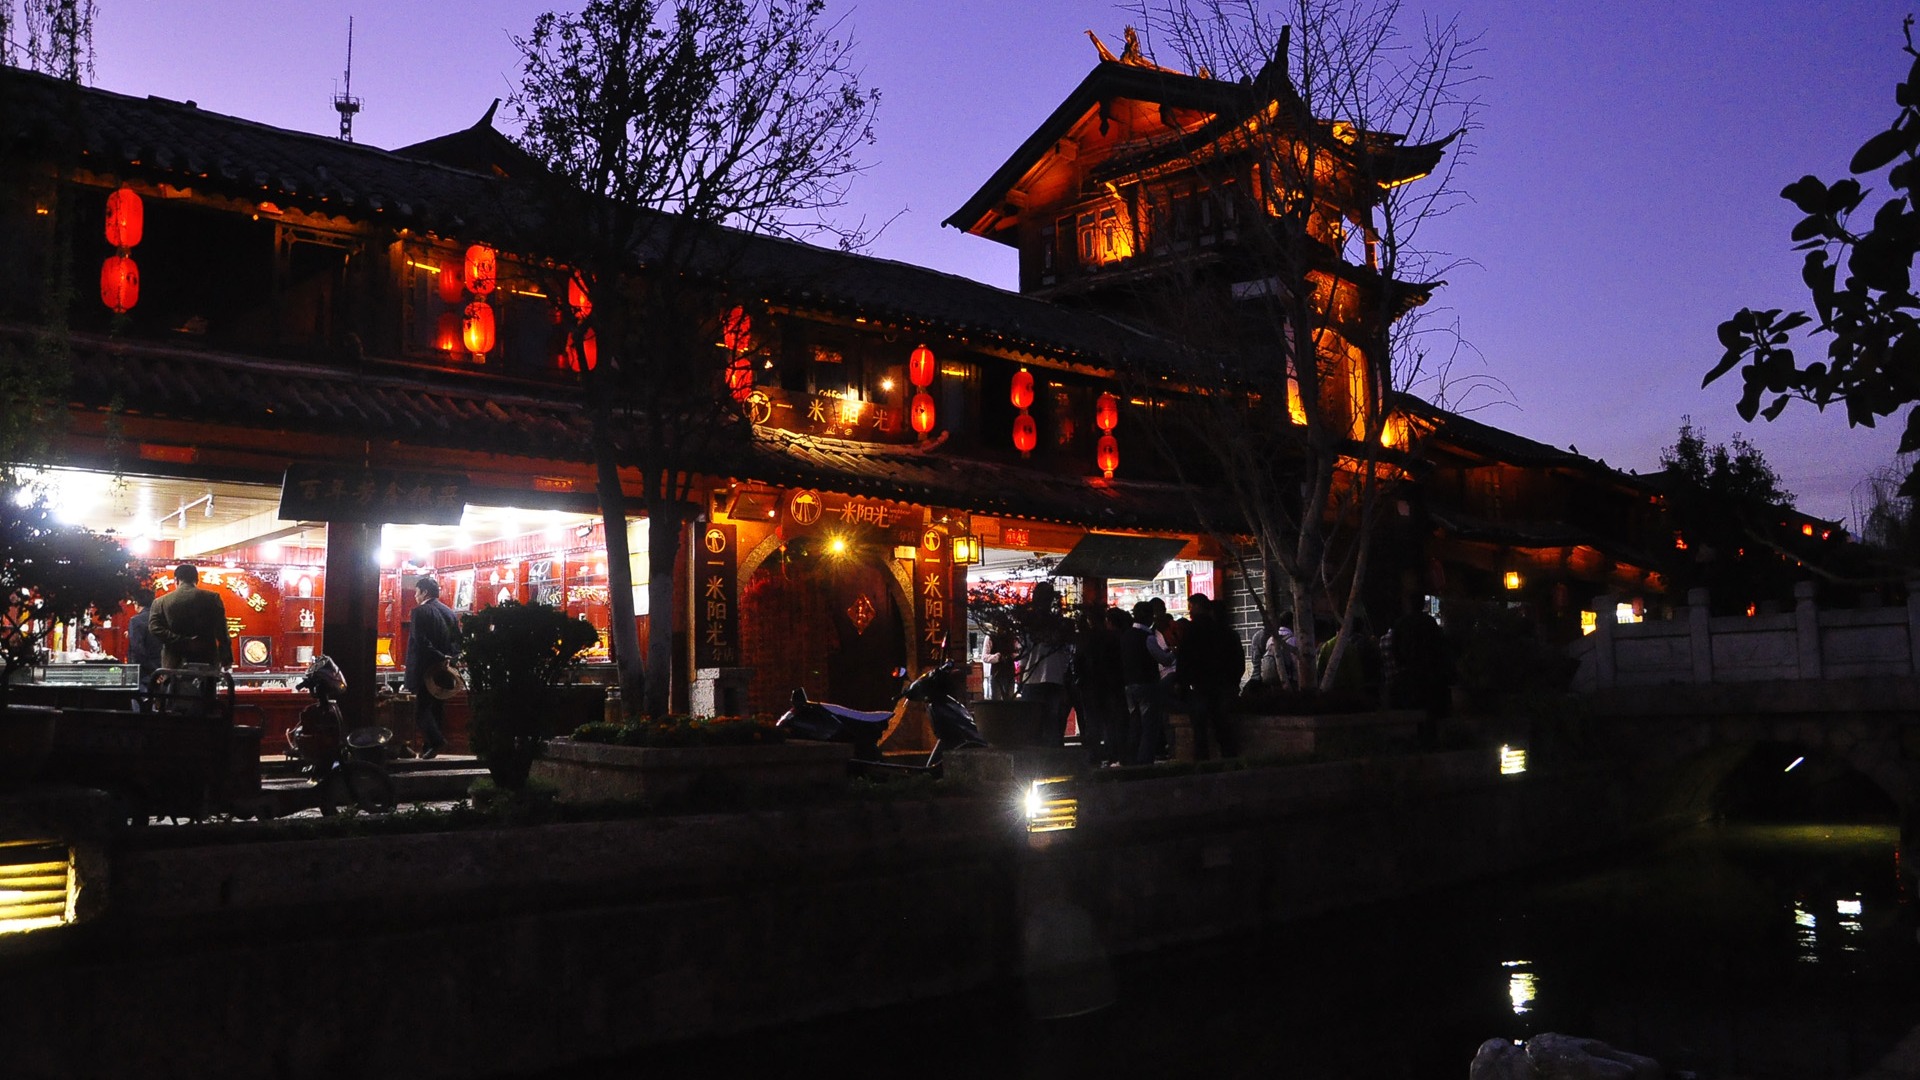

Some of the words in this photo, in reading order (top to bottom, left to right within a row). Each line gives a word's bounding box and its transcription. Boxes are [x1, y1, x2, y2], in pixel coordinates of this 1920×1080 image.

[776, 398, 891, 432] 一米阳光
[825, 501, 890, 529] 一米阳光
[704, 560, 727, 647] 一米阳光
[923, 557, 944, 645] 一米阳光
